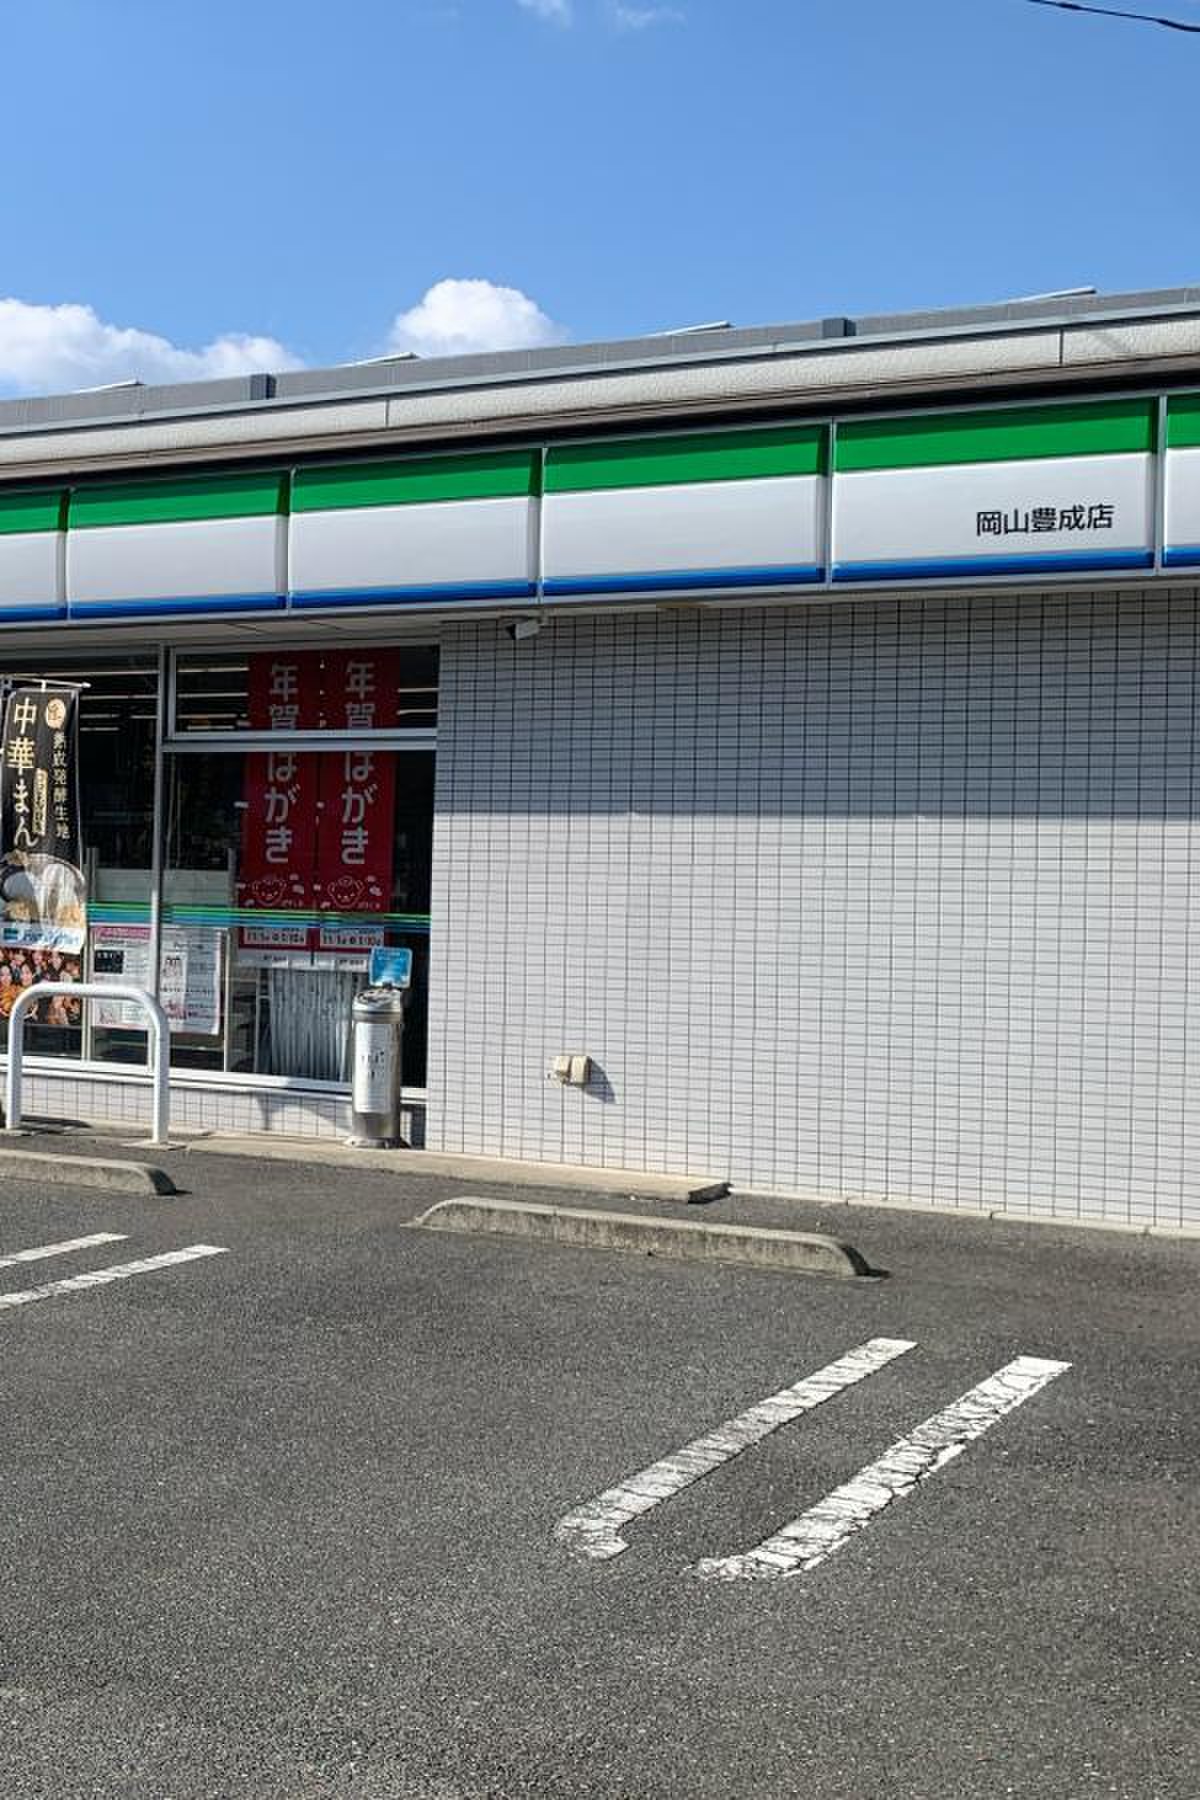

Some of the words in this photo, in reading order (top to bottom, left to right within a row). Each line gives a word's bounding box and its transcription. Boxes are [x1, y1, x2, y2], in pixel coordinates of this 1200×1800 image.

[976, 504, 1115, 536] 岡山豊成店
[6, 697, 39, 847] 中華まん
[264, 664, 301, 864] 年賀はがき
[341, 661, 378, 864] 年賀はがき
